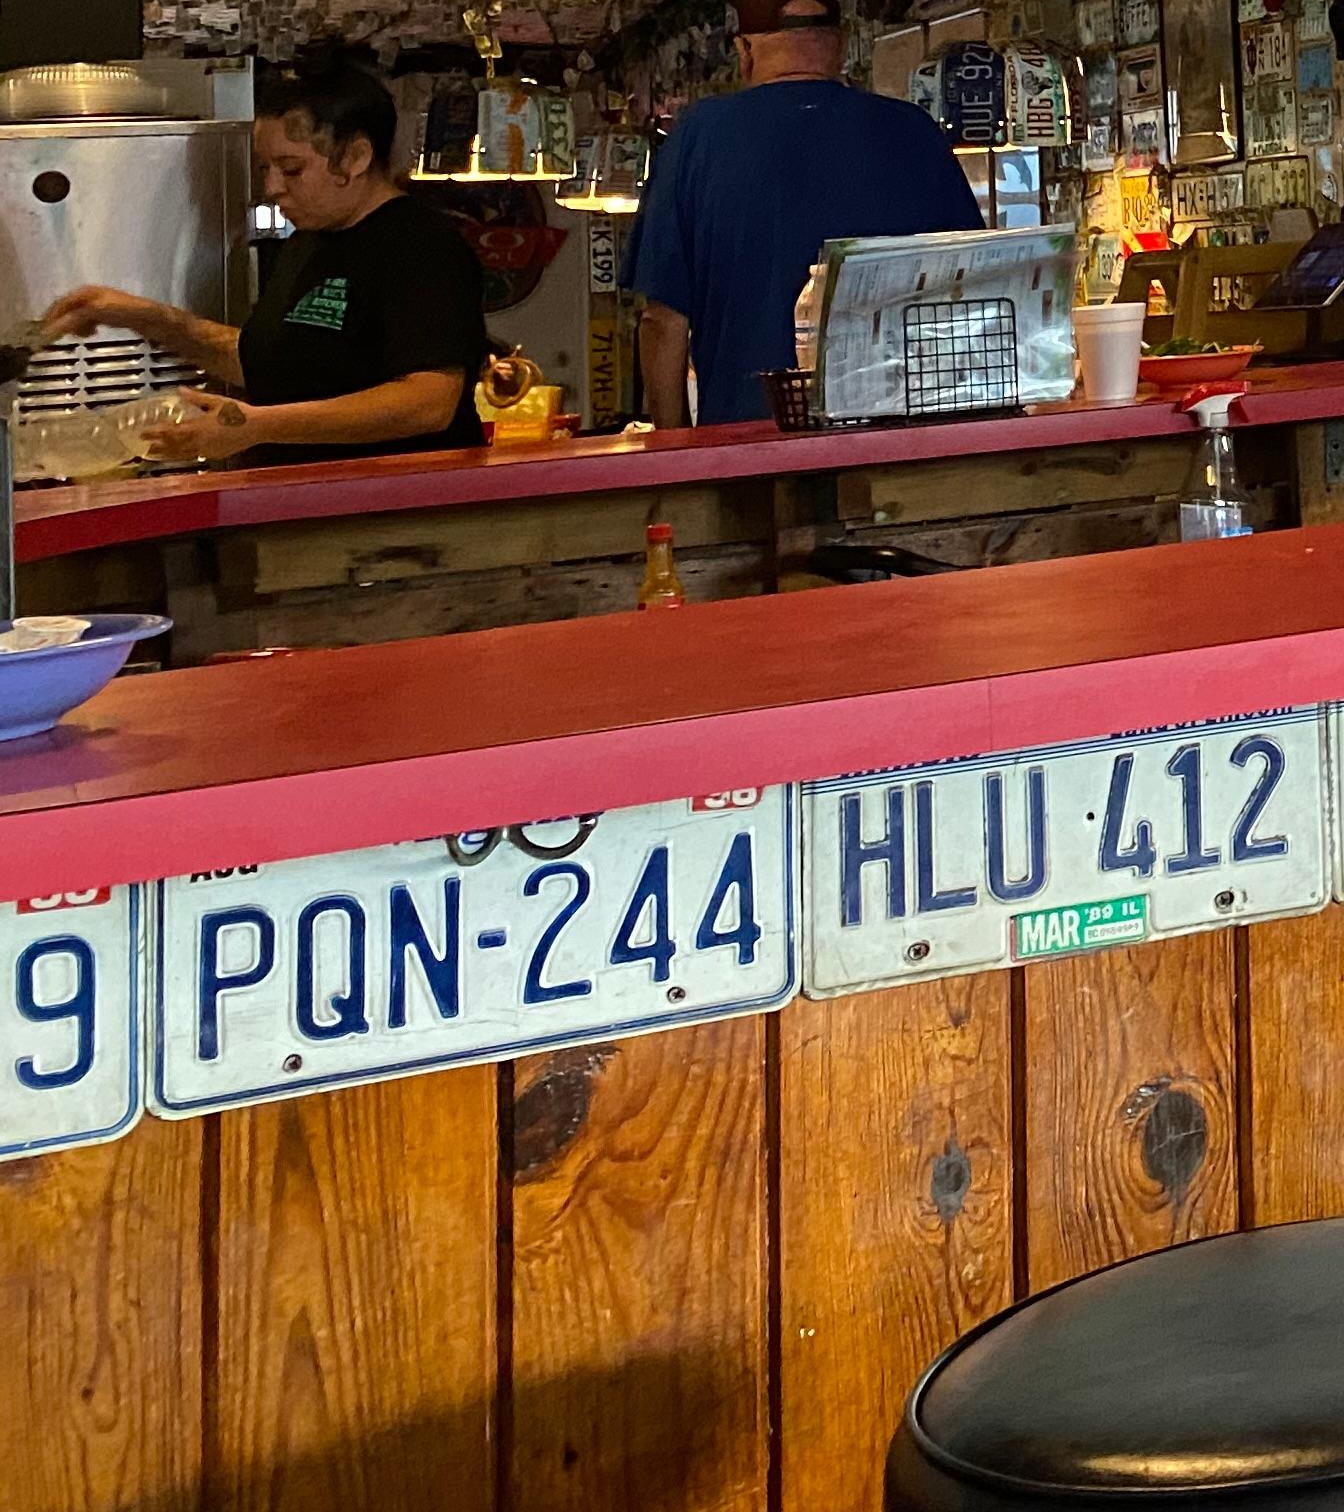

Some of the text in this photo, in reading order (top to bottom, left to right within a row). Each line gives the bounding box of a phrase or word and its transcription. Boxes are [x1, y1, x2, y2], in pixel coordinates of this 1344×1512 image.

[840, 734, 1290, 929] HLU 412
[14, 932, 98, 1091] 9
[199, 829, 764, 1064] PQN-244
[1021, 914, 1081, 957] MAR
